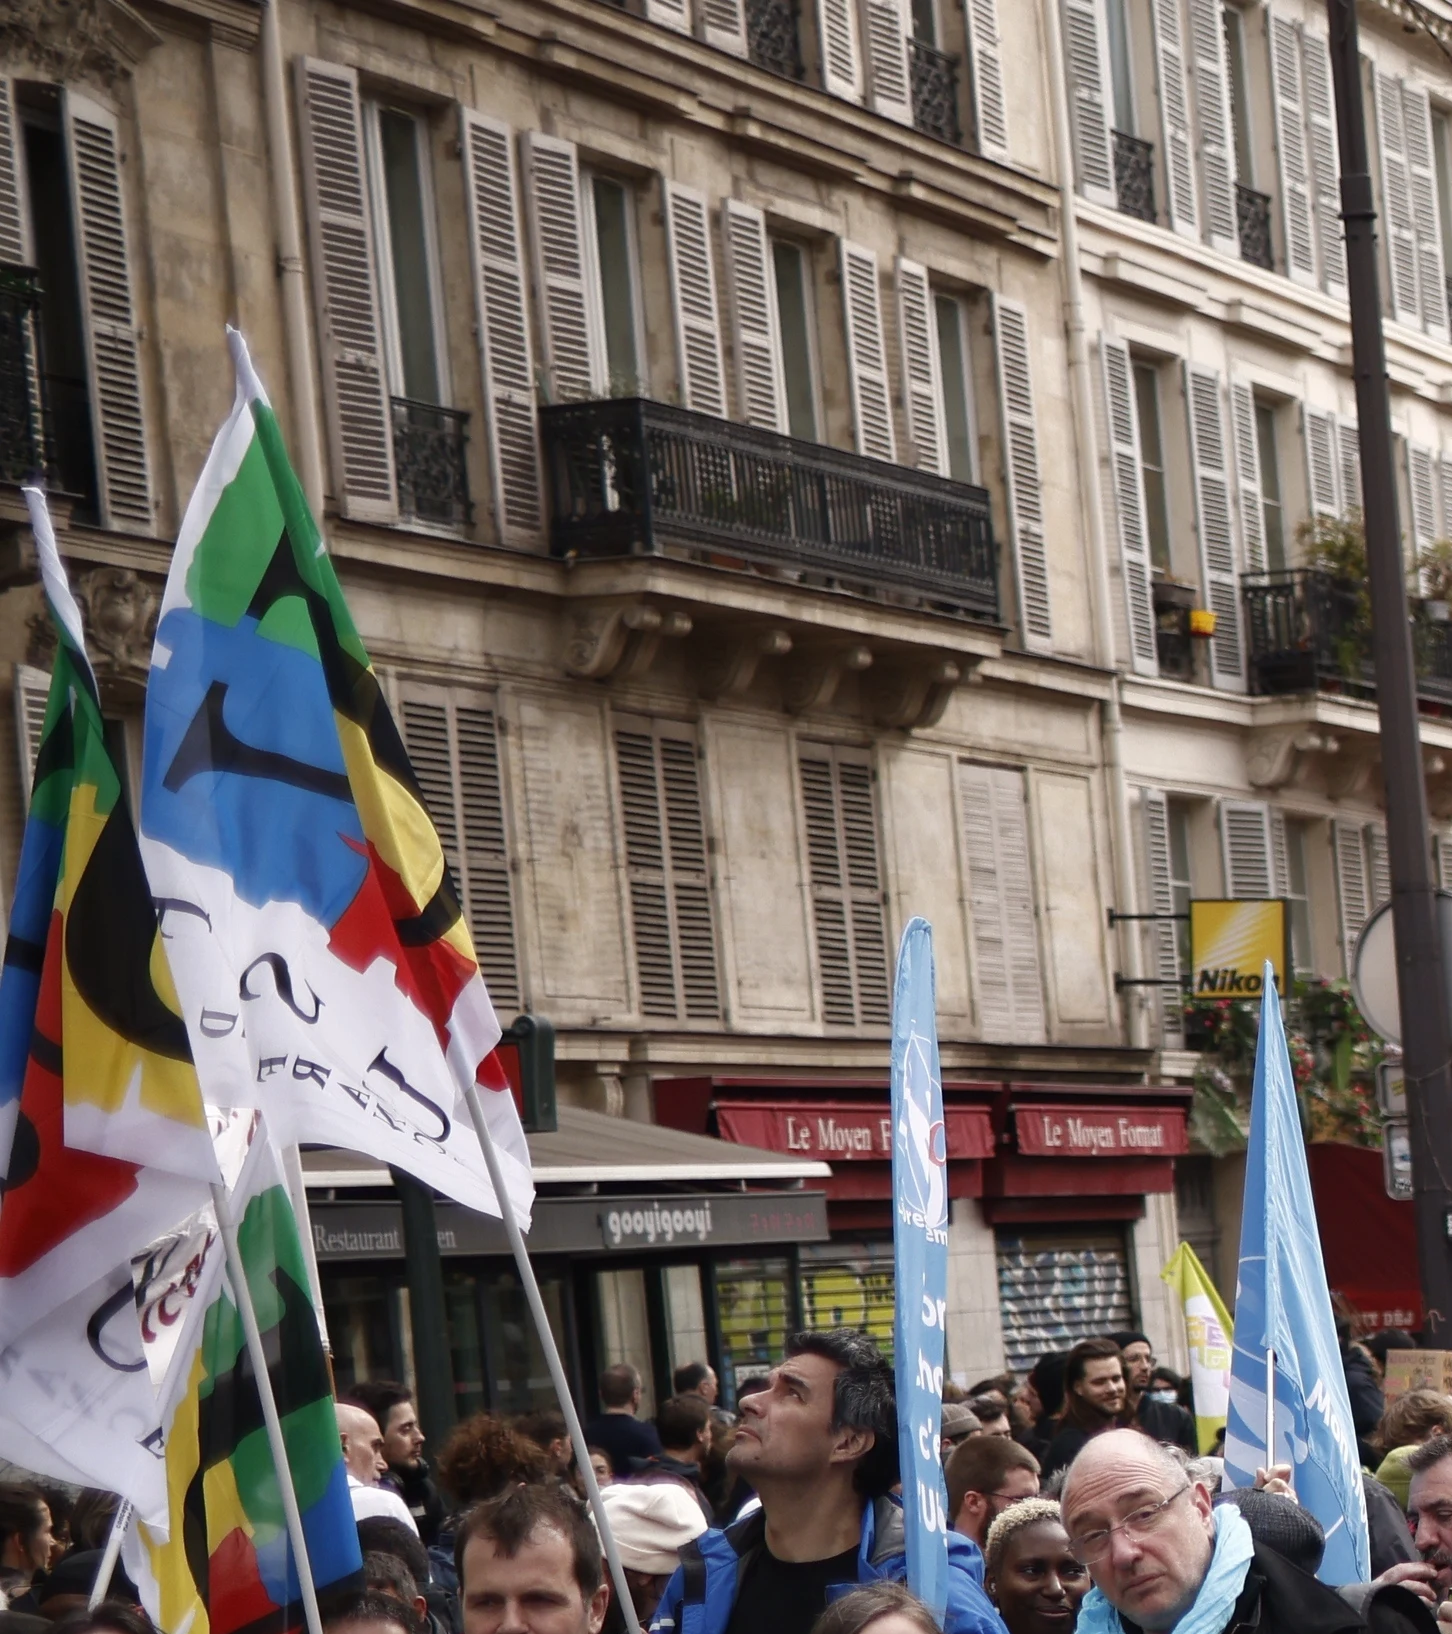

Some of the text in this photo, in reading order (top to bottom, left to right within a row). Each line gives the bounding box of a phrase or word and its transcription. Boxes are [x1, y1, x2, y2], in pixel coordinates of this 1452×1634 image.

[787, 1117, 810, 1150] Le
[817, 1118, 872, 1159] Moyen
[1043, 1116, 1164, 1155] Le Moyen Format
[314, 1225, 401, 1251] Restaurant
